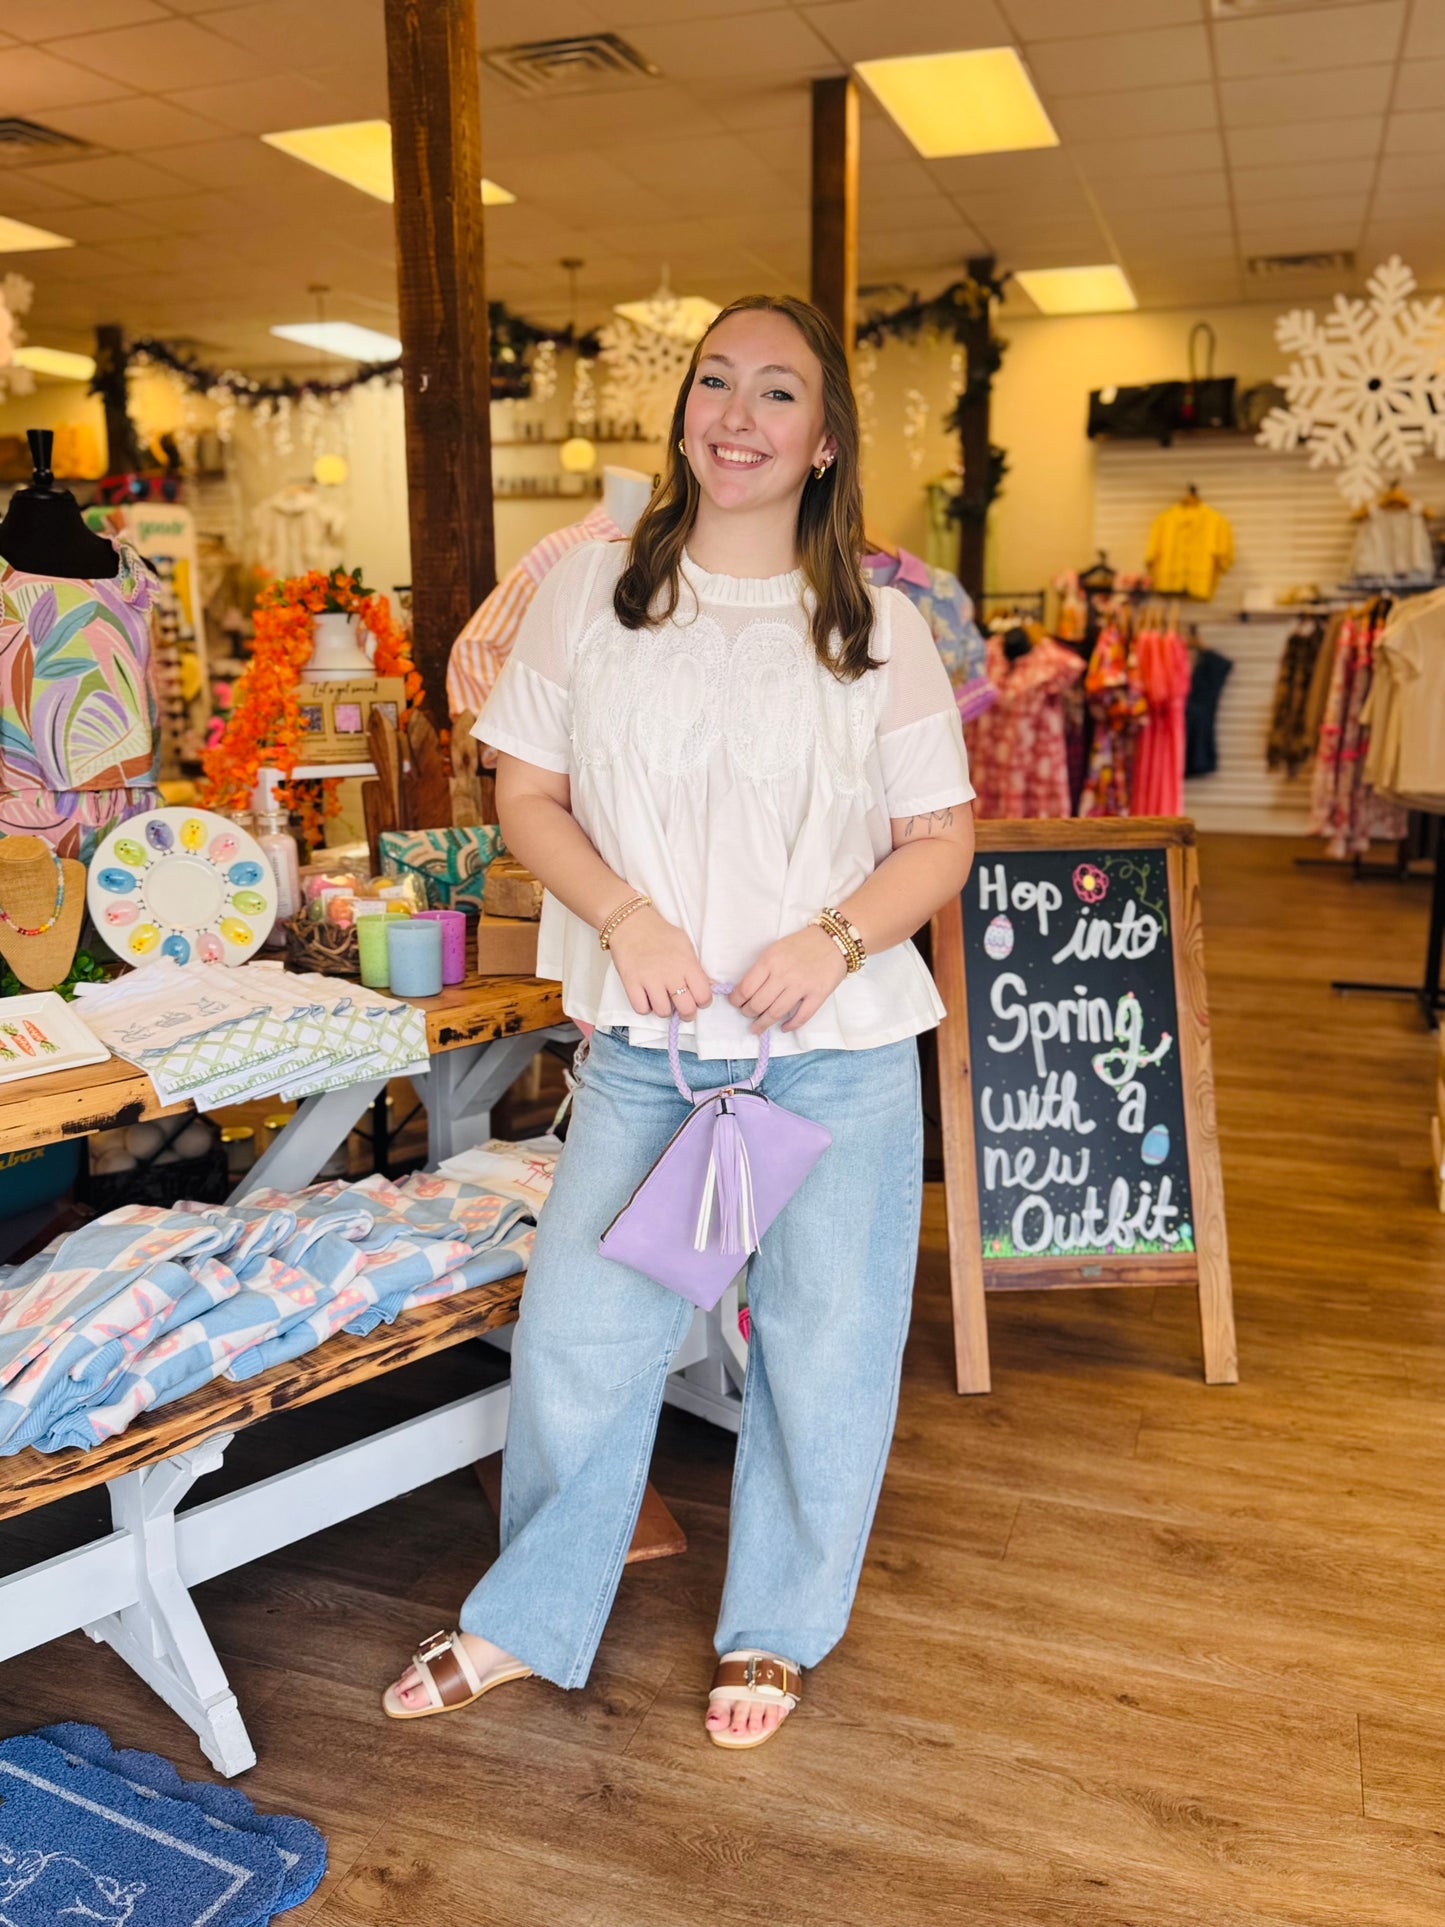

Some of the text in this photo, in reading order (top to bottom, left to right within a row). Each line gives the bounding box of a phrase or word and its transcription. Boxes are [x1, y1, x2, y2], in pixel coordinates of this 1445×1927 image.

[979, 864, 1062, 935] Hop
[1052, 900, 1162, 964] into
[987, 973, 1172, 1086] Spring
[981, 1071, 1146, 1134] with a
[983, 1146, 1090, 1191] new
[1012, 1175, 1181, 1252] Outfit
